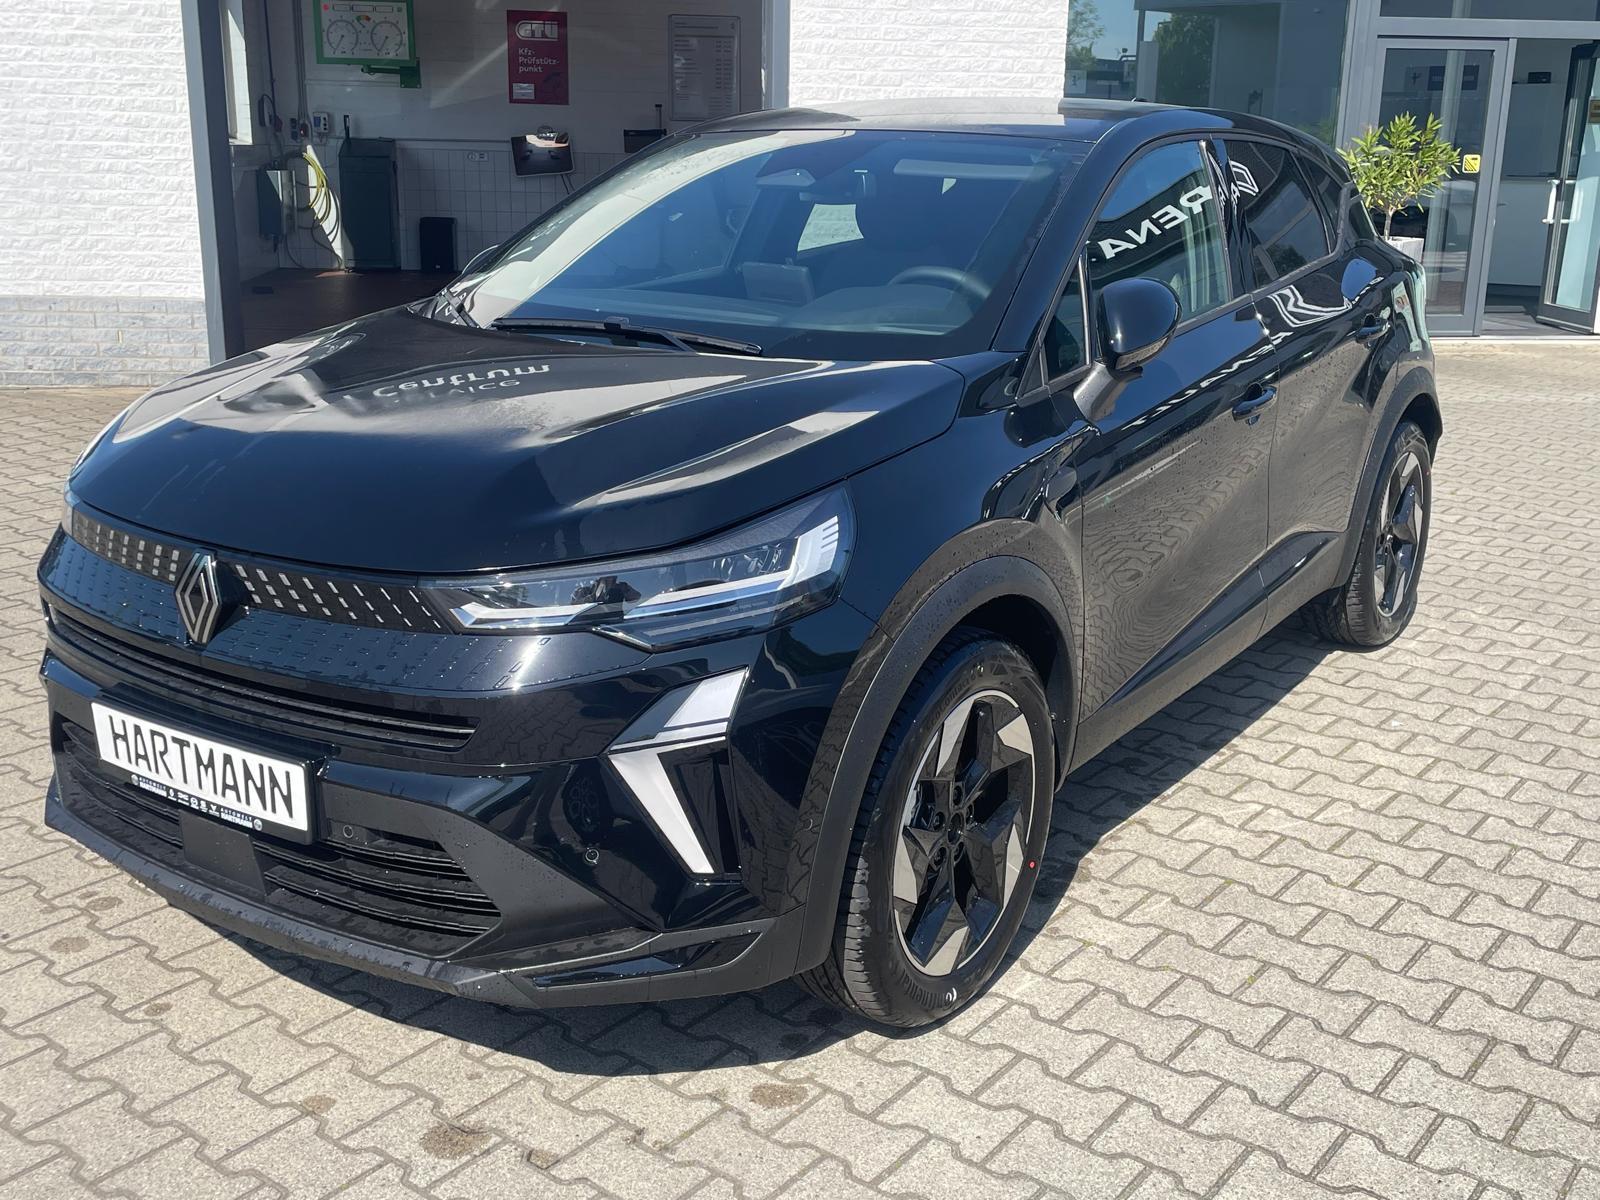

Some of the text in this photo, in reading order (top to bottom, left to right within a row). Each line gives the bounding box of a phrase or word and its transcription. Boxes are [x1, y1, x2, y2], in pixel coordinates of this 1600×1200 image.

[517, 21, 559, 39] GTÜ
[518, 47, 536, 56] Kfz-
[518, 56, 560, 66] Prüfstütz-
[518, 65, 544, 75] punkt
[108, 714, 294, 819] HARTMANN
